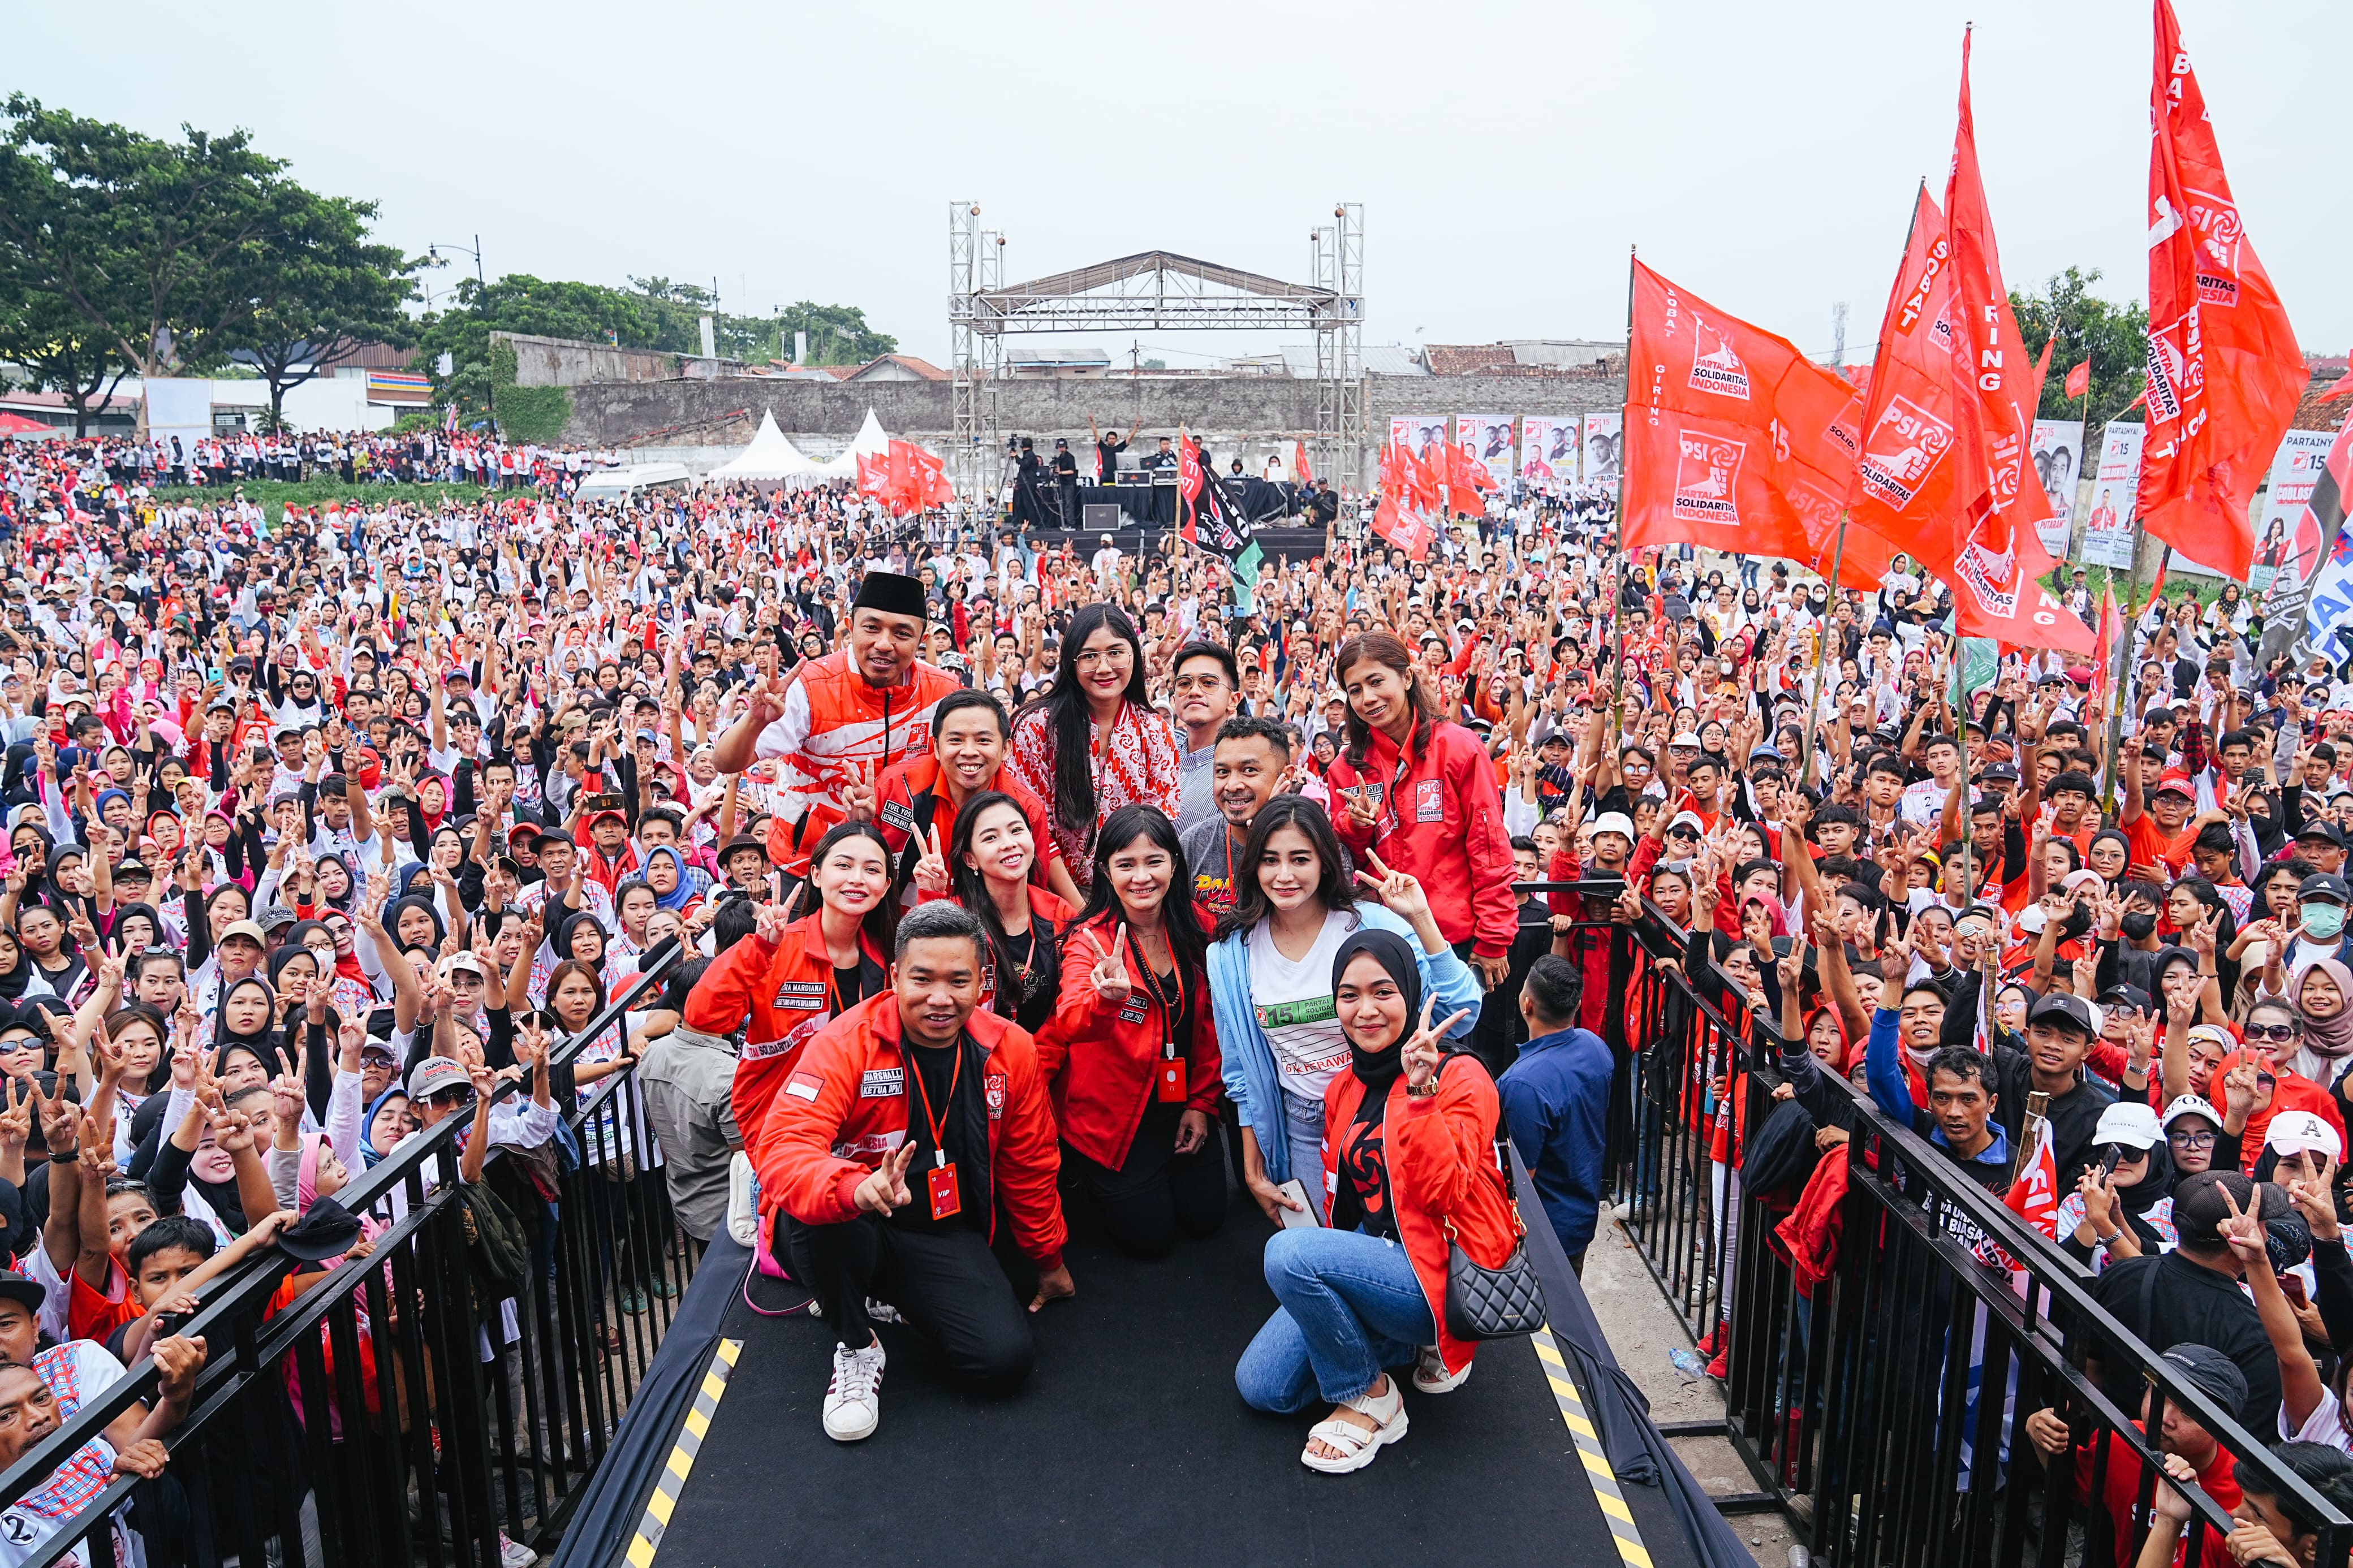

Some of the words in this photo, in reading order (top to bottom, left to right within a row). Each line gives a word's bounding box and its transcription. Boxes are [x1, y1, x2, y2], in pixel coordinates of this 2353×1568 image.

[1901, 241, 1947, 327] SOBAT
[2153, 336, 2175, 375] PARTAI
[1696, 358, 1725, 371] PARTAI
[1693, 368, 1747, 386] SOLIDARITAS
[2147, 340, 2177, 416] SOLIDARITAS
[1690, 377, 1747, 396] INDONESIA
[1648, 365, 1666, 426] GIRING
[1882, 404, 1921, 440] PSI
[1770, 417, 1790, 462] 15
[2048, 427, 2054, 437] 15
[1680, 440, 1709, 462] PSI
[2120, 443, 2128, 455] 15
[2309, 455, 2326, 470] 15
[1861, 465, 1911, 501] OLIDARITAS
[1678, 489, 1712, 500] PARTAI
[1676, 498, 1735, 513] SOLIDARITAS
[1675, 507, 1738, 522] INDONESIA
[1968, 541, 1990, 575] PARTAI
[1964, 548, 2013, 604] SOLIDARITAS
[1956, 559, 2010, 616] INDONESIA
[1417, 783, 1431, 794] PSI
[887, 802, 900, 813] YOEL
[1924, 796, 1931, 807] 2
[899, 819, 908, 830] KOTA
[1305, 999, 1329, 1008] PARTAI
[1268, 1007, 1294, 1026] 15
[1306, 1010, 1336, 1021] INDONE
[759, 1038, 792, 1056] SOLIDARITAS
[864, 1067, 902, 1082] MARSHALL
[863, 1085, 887, 1095] KETUA
[889, 1083, 901, 1093] DPW
[2300, 1120, 2321, 1137] A
[938, 1189, 950, 1198] VIP
[5, 1514, 32, 1541] 2
